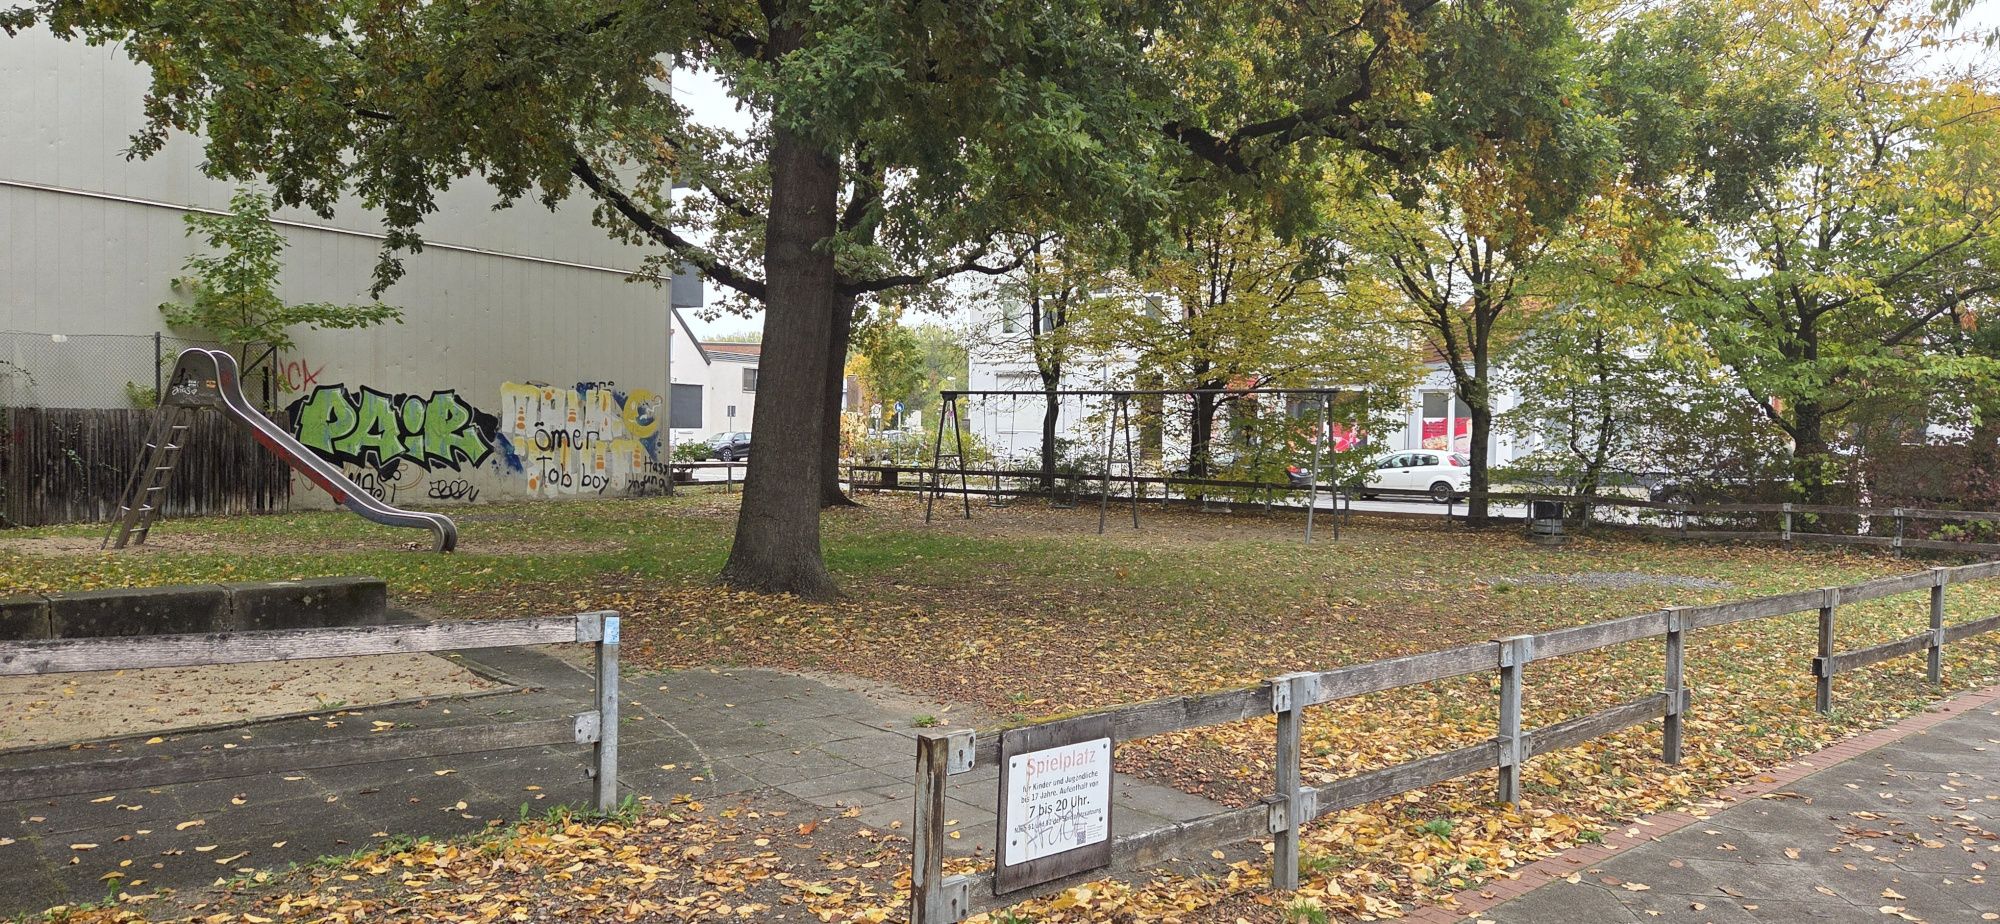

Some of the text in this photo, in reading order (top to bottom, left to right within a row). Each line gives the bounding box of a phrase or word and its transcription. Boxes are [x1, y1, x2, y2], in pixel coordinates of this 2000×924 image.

[582, 463, 609, 494] boy
[1026, 749, 1096, 778] Spielplatz
[1031, 793, 1039, 802] 17
[1040, 790, 1059, 800] Jahre.
[1059, 782, 1088, 794] Aufenthalt
[1089, 780, 1099, 788] von
[1033, 781, 1052, 791] Kinder
[1053, 778, 1064, 786] und
[1065, 771, 1099, 783] Jugendliche
[1029, 795, 1090, 819] 7 bis 20 Uhr.
